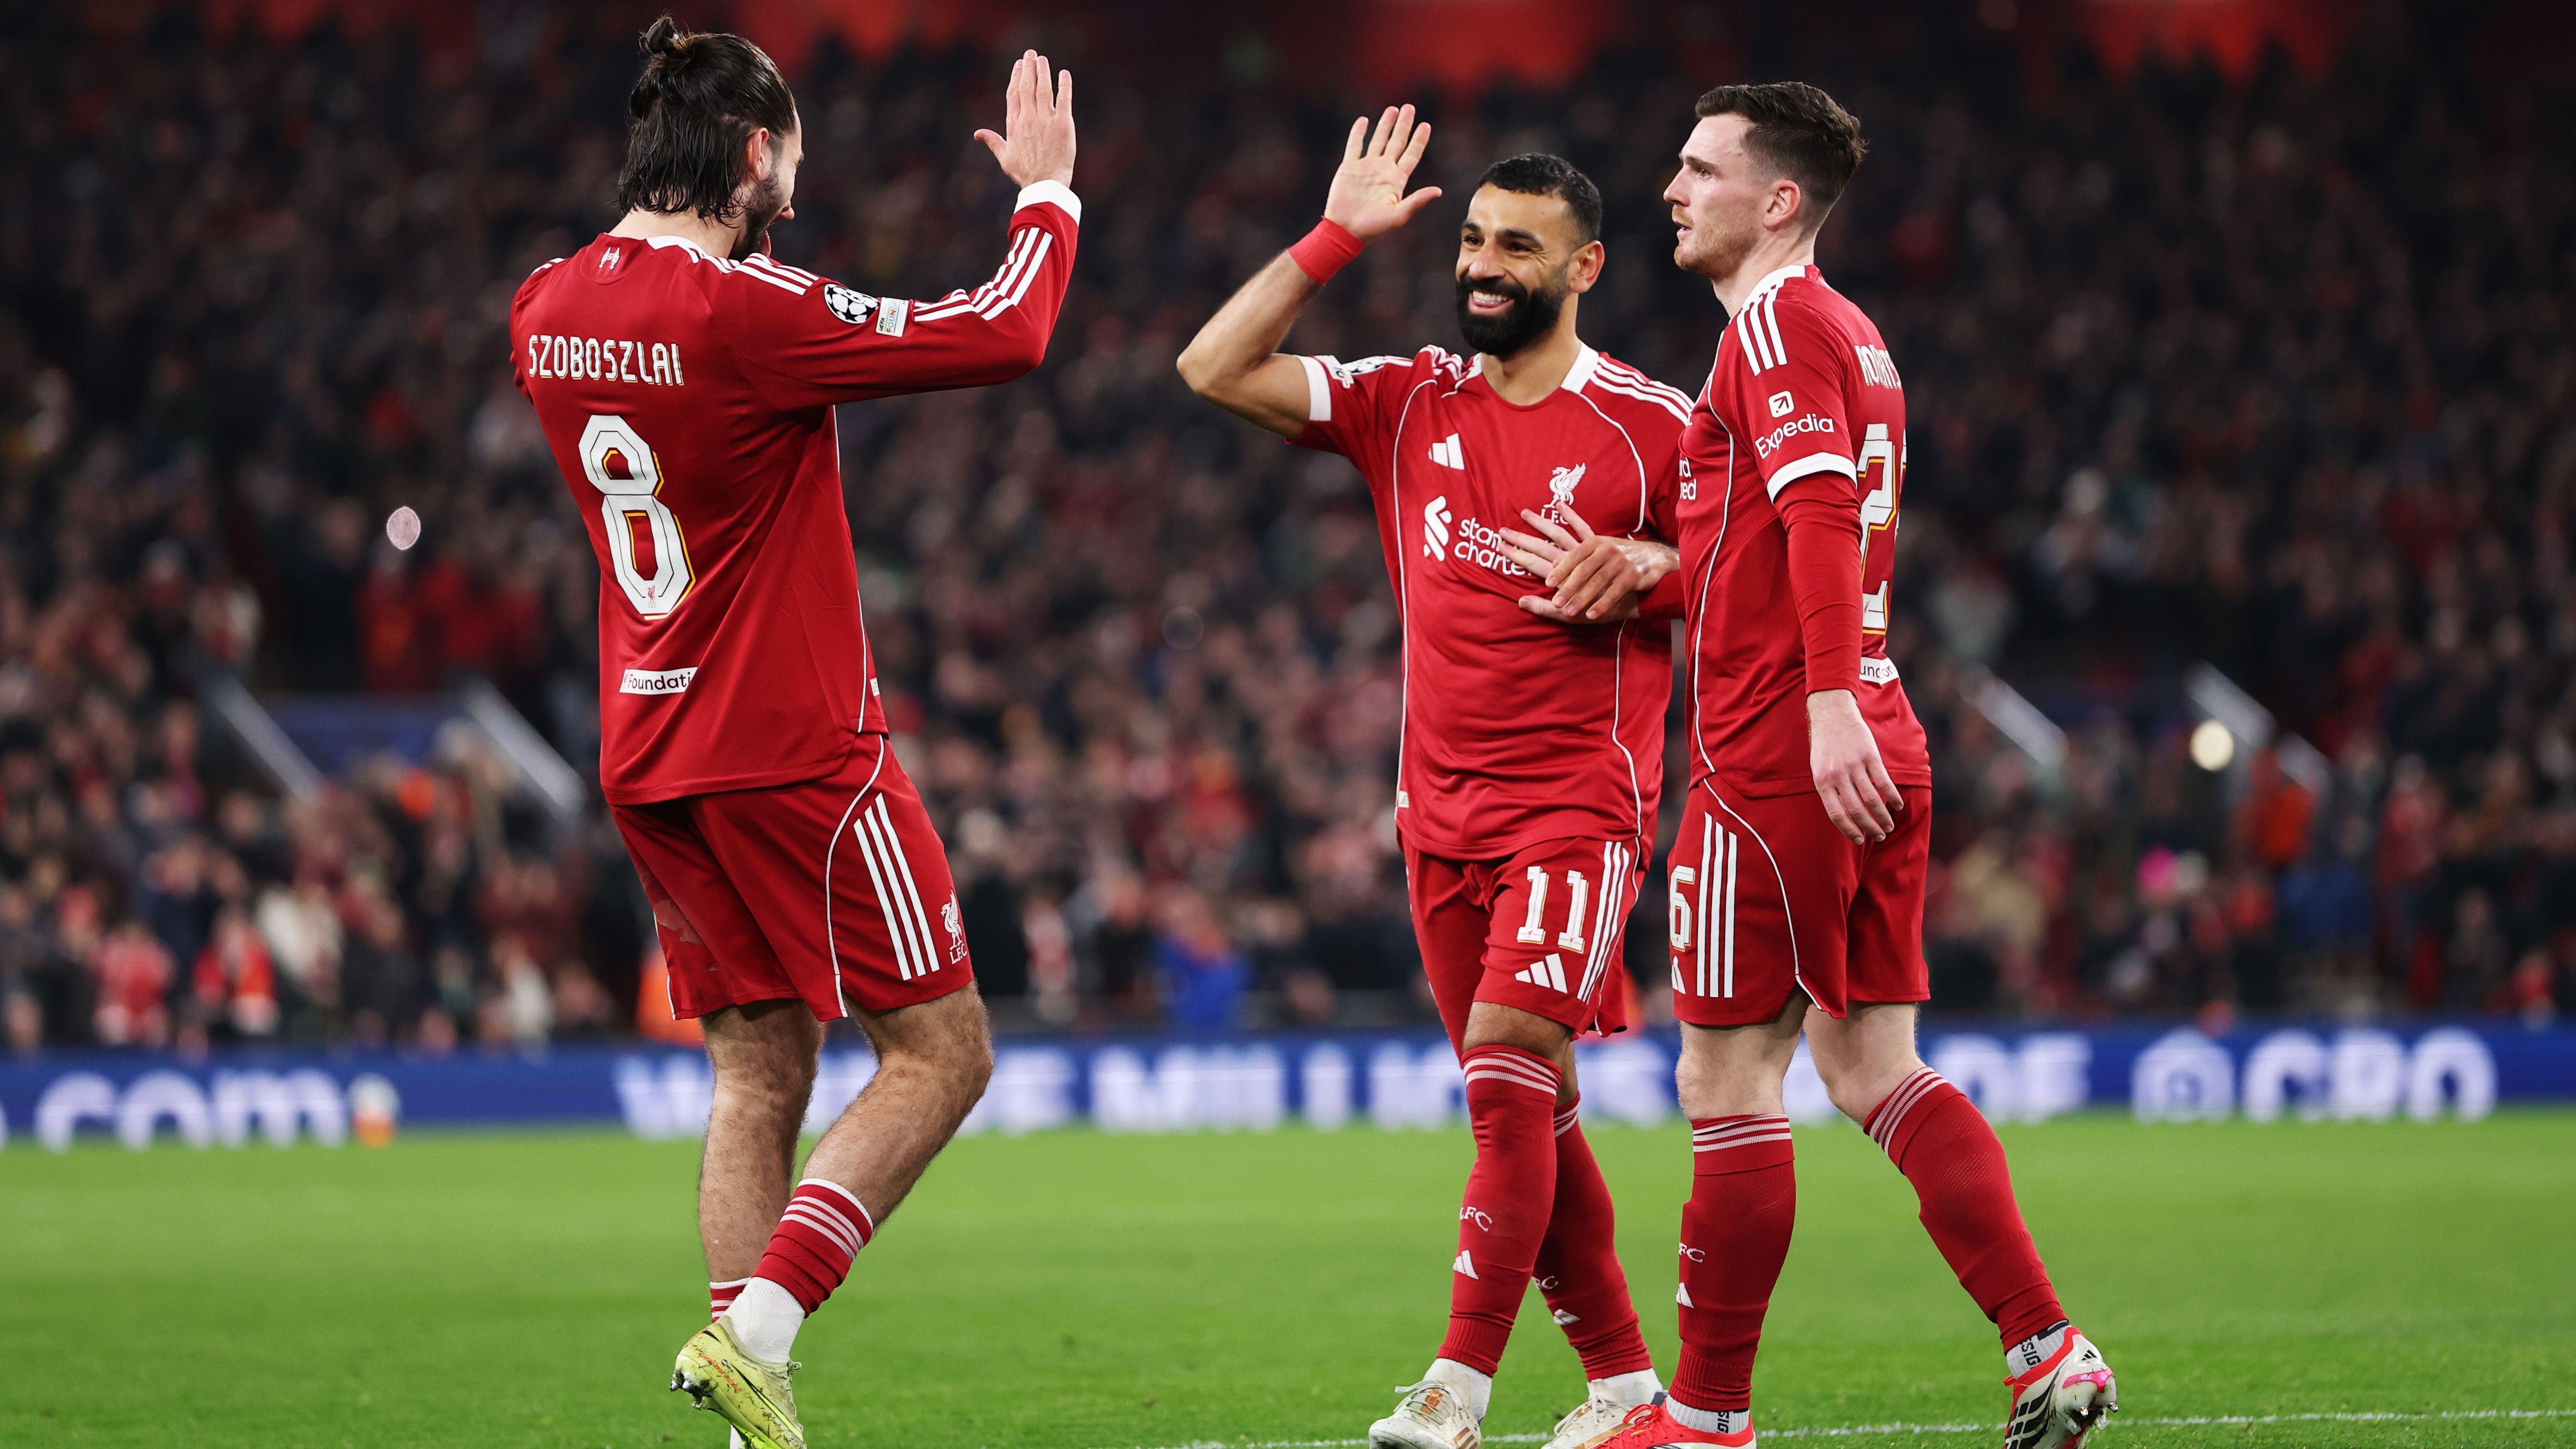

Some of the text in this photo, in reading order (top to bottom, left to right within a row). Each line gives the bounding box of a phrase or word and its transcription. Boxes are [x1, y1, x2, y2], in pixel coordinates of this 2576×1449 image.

[528, 334, 684, 387] SZOBOSZLAI
[1755, 413, 1835, 460] Expedia
[578, 415, 696, 621] 8
[1454, 540, 1532, 576] charte
[1516, 866, 1589, 955] 11
[1670, 865, 1696, 952] 6
[2021, 1338, 2042, 1369] SIG
[1717, 1410, 1730, 1433] SIG
